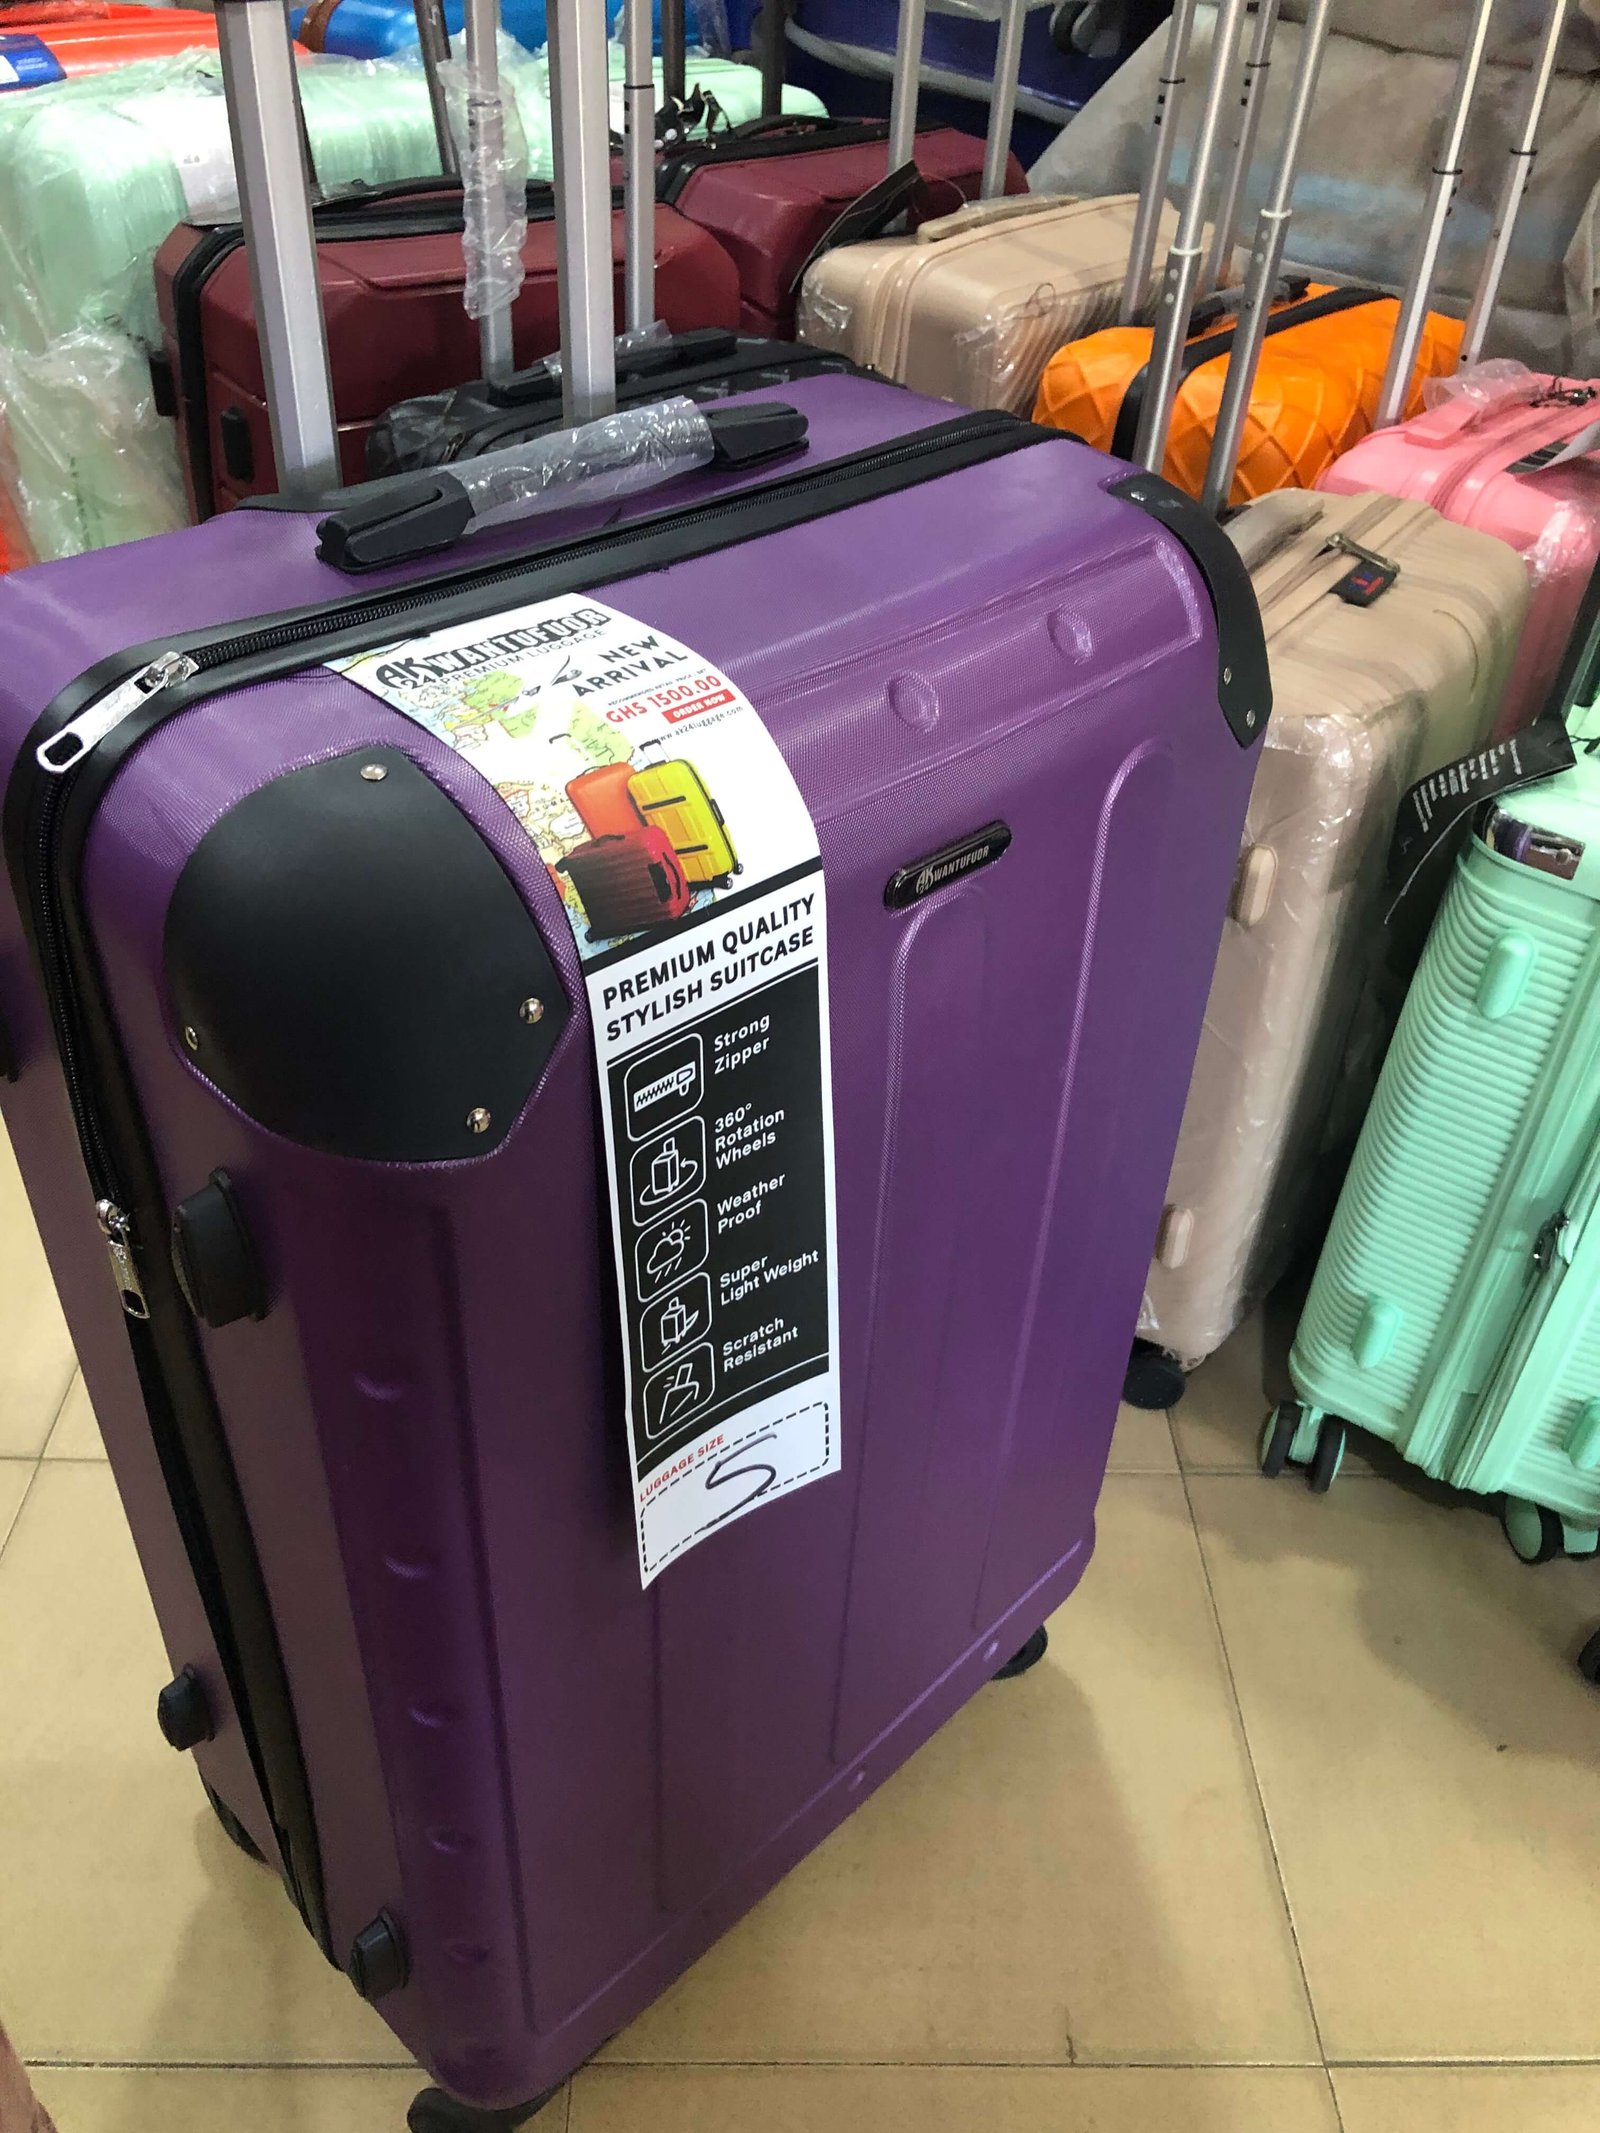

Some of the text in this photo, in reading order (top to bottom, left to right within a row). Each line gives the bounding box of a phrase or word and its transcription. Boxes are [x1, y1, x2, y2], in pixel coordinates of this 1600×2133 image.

[440, 629, 608, 685] PREMIUM LUGGAGE
[598, 635, 660, 663] NEW
[572, 651, 688, 697] ARRIVAL
[606, 702, 648, 723] GHS
[646, 675, 722, 708] 1500.00
[672, 693, 727, 719] ORDER NOW
[603, 893, 815, 1010] PREMIUM QUALITY
[606, 926, 814, 1041] STYLISH SUITCASE
[714, 1015, 770, 1052] Strong
[714, 1037, 770, 1074] Zipper
[714, 1103, 752, 1133] 360°
[715, 1109, 785, 1152] Rotation
[716, 1131, 776, 1169] Wheels
[717, 1174, 785, 1215] Weather
[718, 1201, 762, 1234] Proof
[720, 1256, 768, 1288] Super
[721, 1250, 819, 1305] Light Weight
[723, 1317, 784, 1356] Scratch
[723, 1326, 799, 1372] Resistant
[640, 1434, 725, 1502] LUGGAGE SIZE
